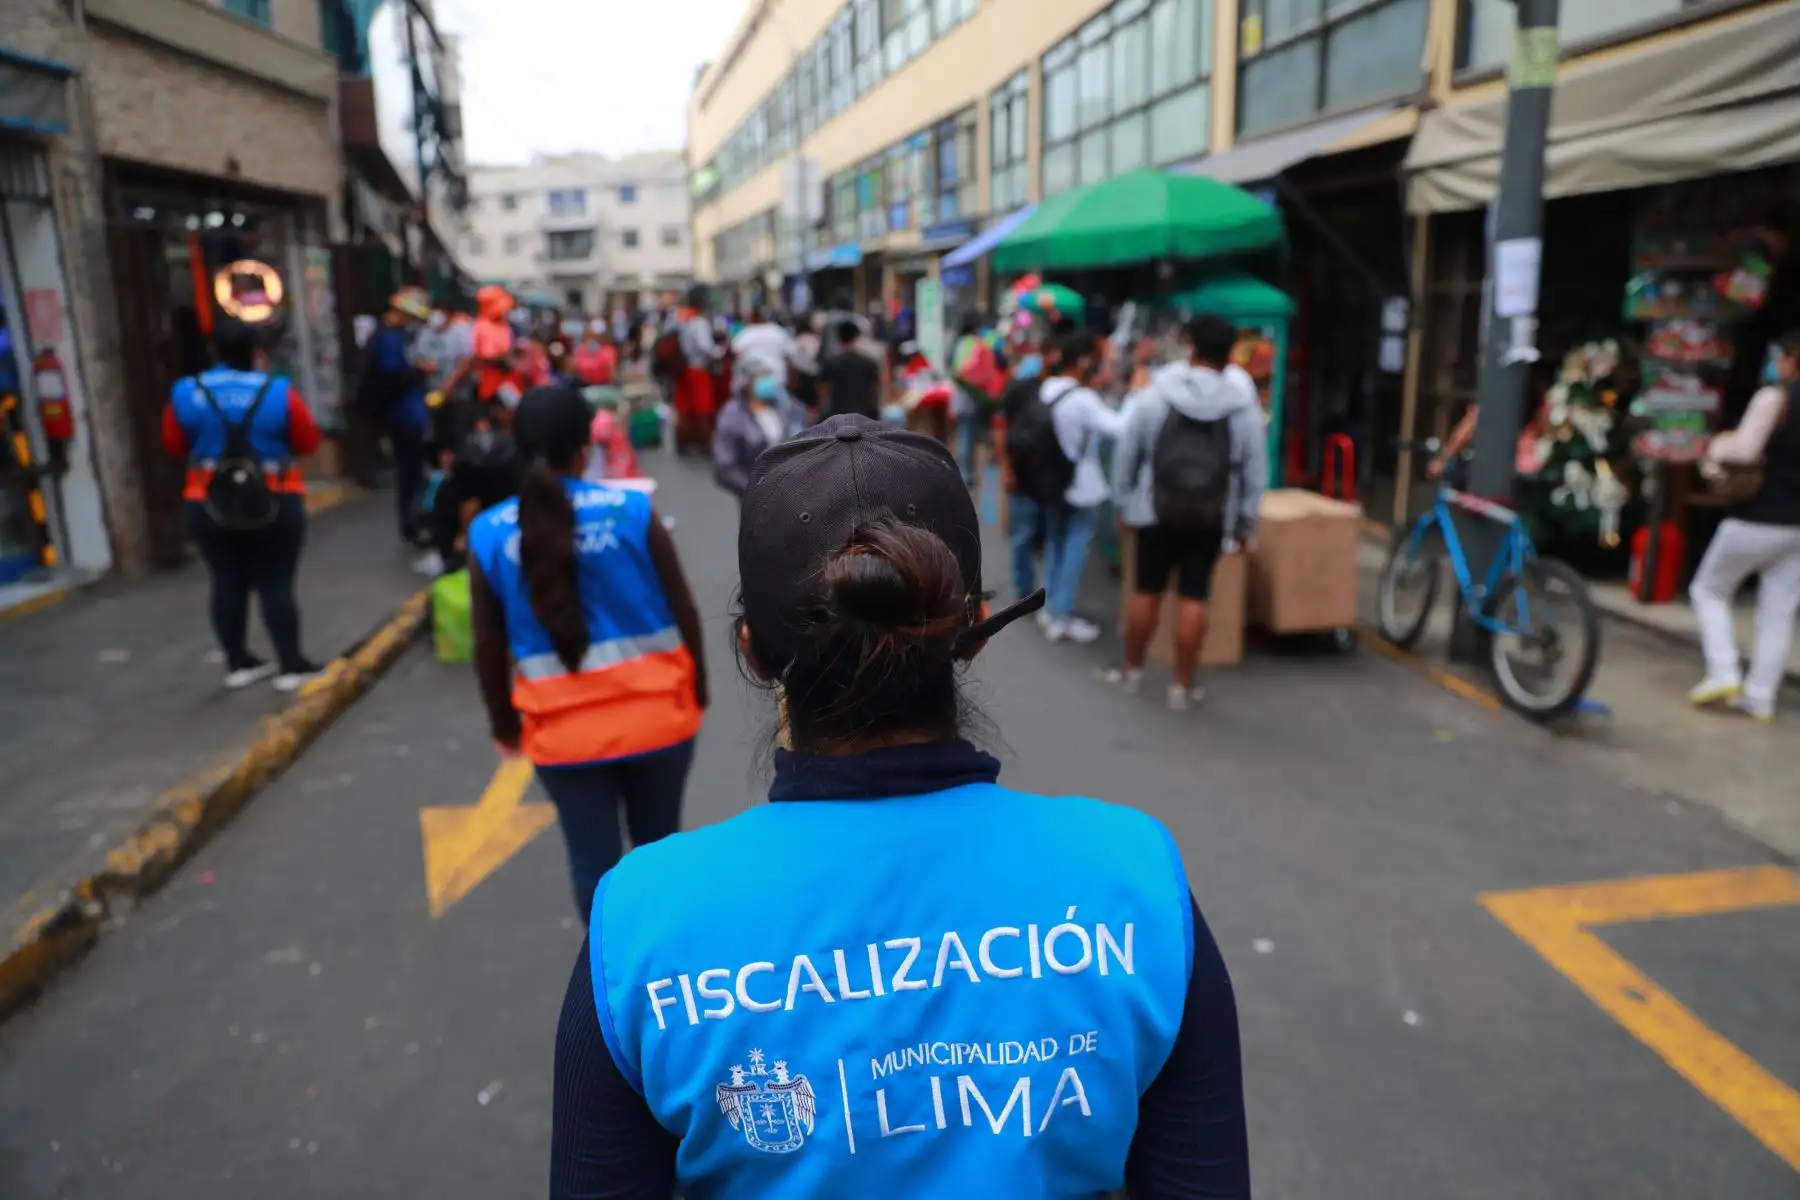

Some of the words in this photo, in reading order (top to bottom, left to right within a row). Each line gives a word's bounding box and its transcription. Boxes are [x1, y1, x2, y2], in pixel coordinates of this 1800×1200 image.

[646, 905, 1136, 1031] FISCALIZACIÓN
[871, 1037, 1060, 1080] MUNICIPALIDAD
[1069, 1030, 1099, 1056] DE
[875, 1066, 1093, 1138] LIMA
